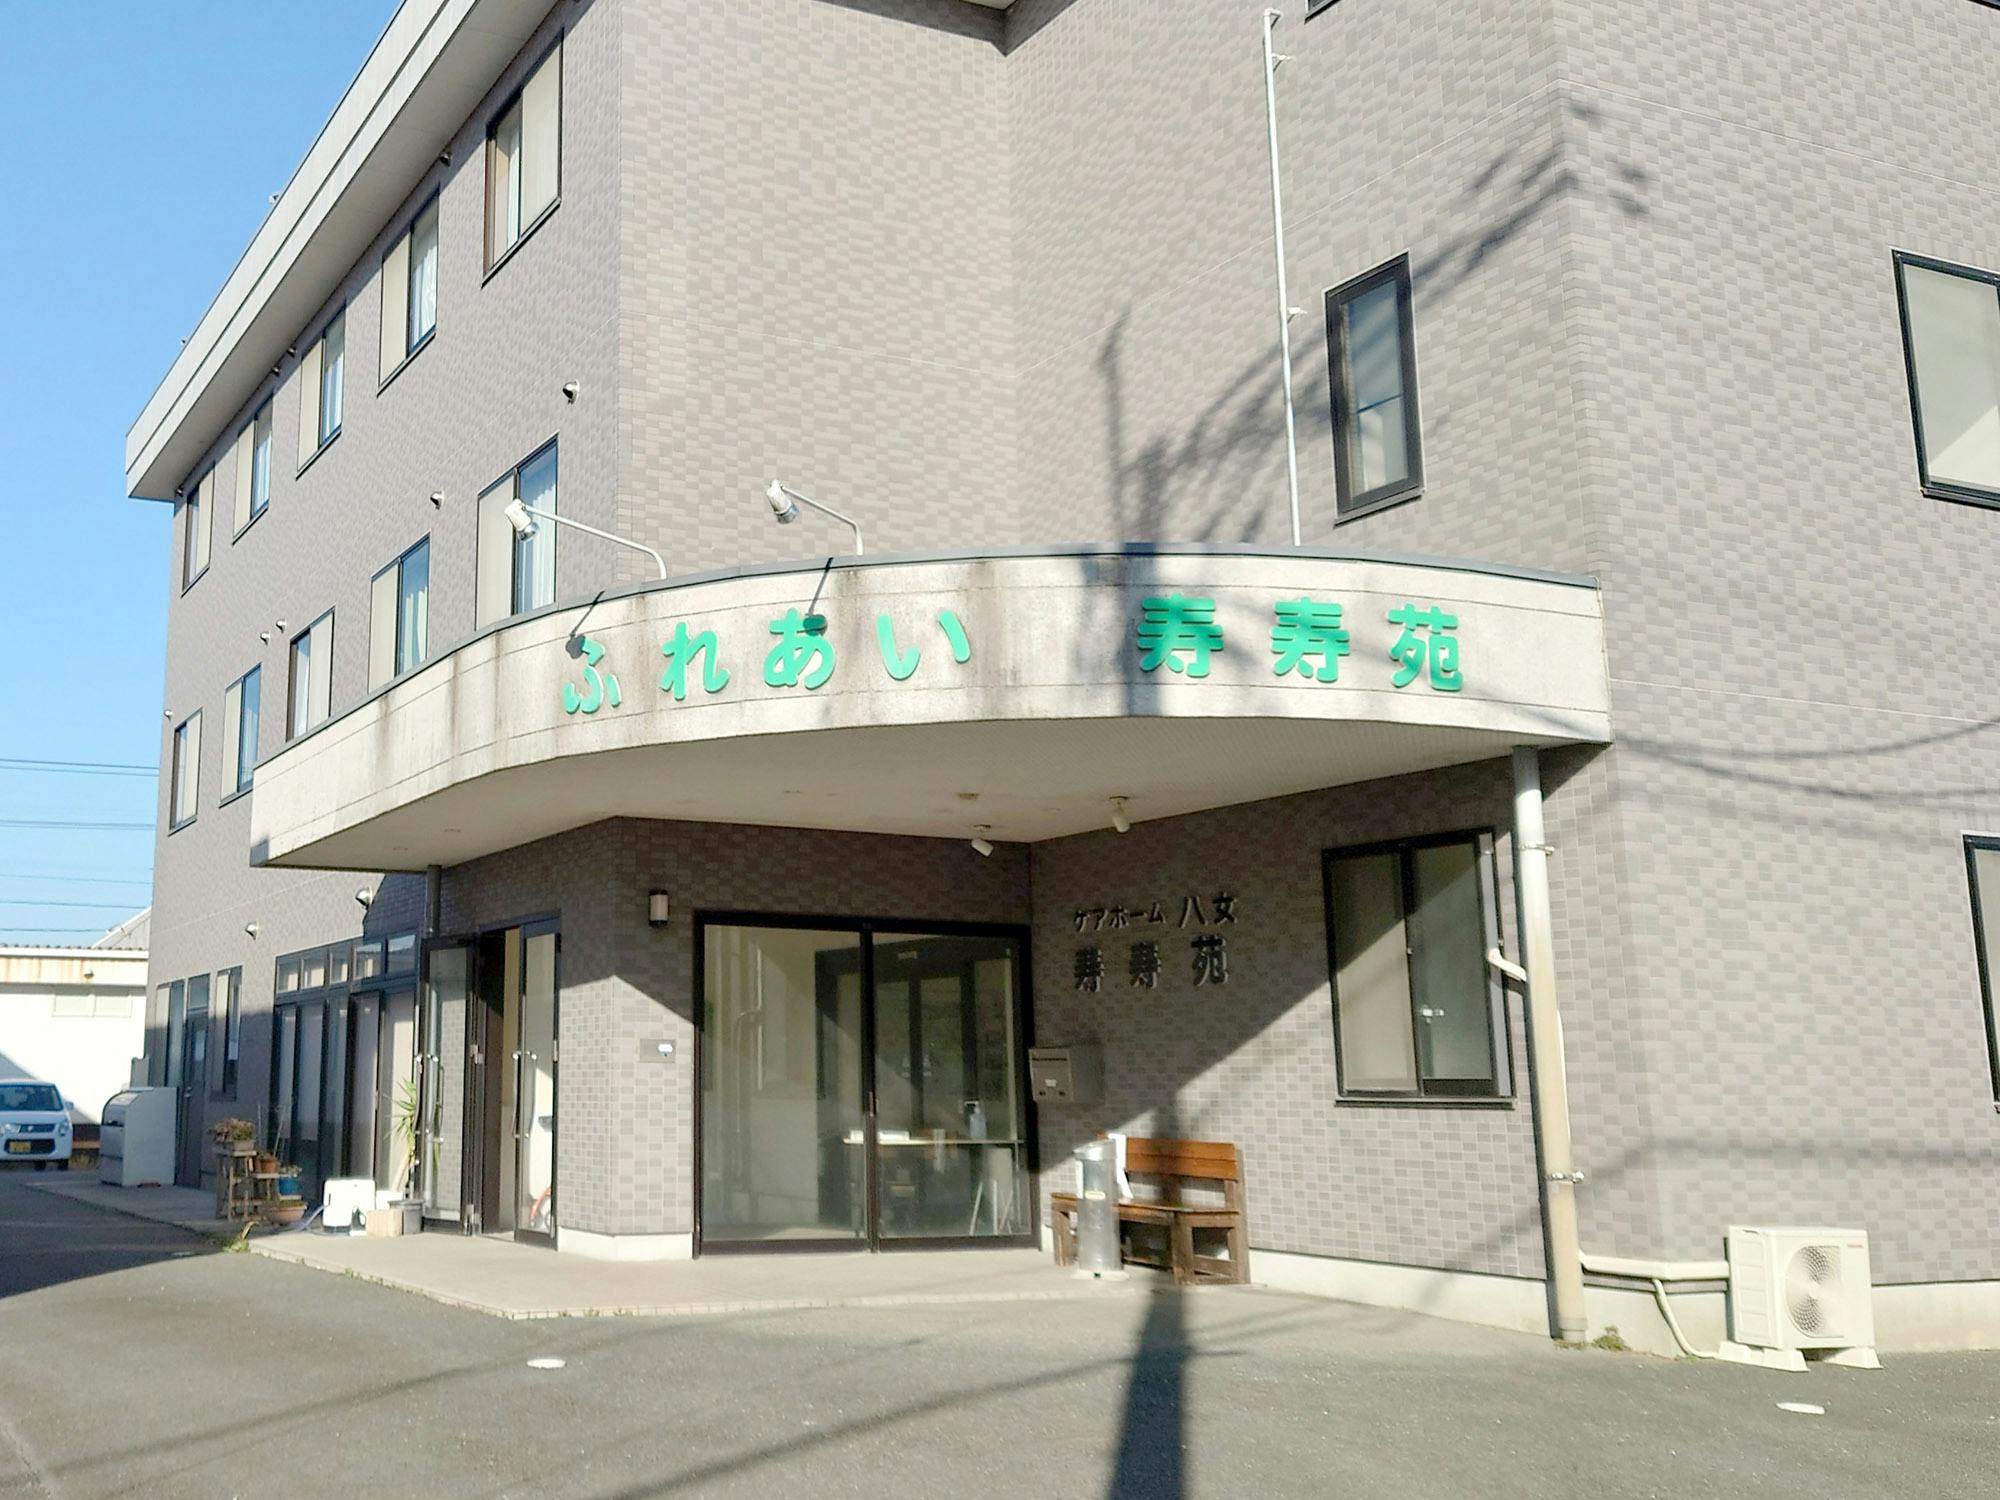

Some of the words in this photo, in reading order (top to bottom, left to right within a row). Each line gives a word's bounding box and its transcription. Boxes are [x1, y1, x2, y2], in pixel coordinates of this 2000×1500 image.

[563, 608, 971, 713] ふれあい
[1137, 592, 1463, 692] 寿寿苑
[1074, 902, 1166, 932] ケアホーム
[1179, 892, 1238, 929] 八女
